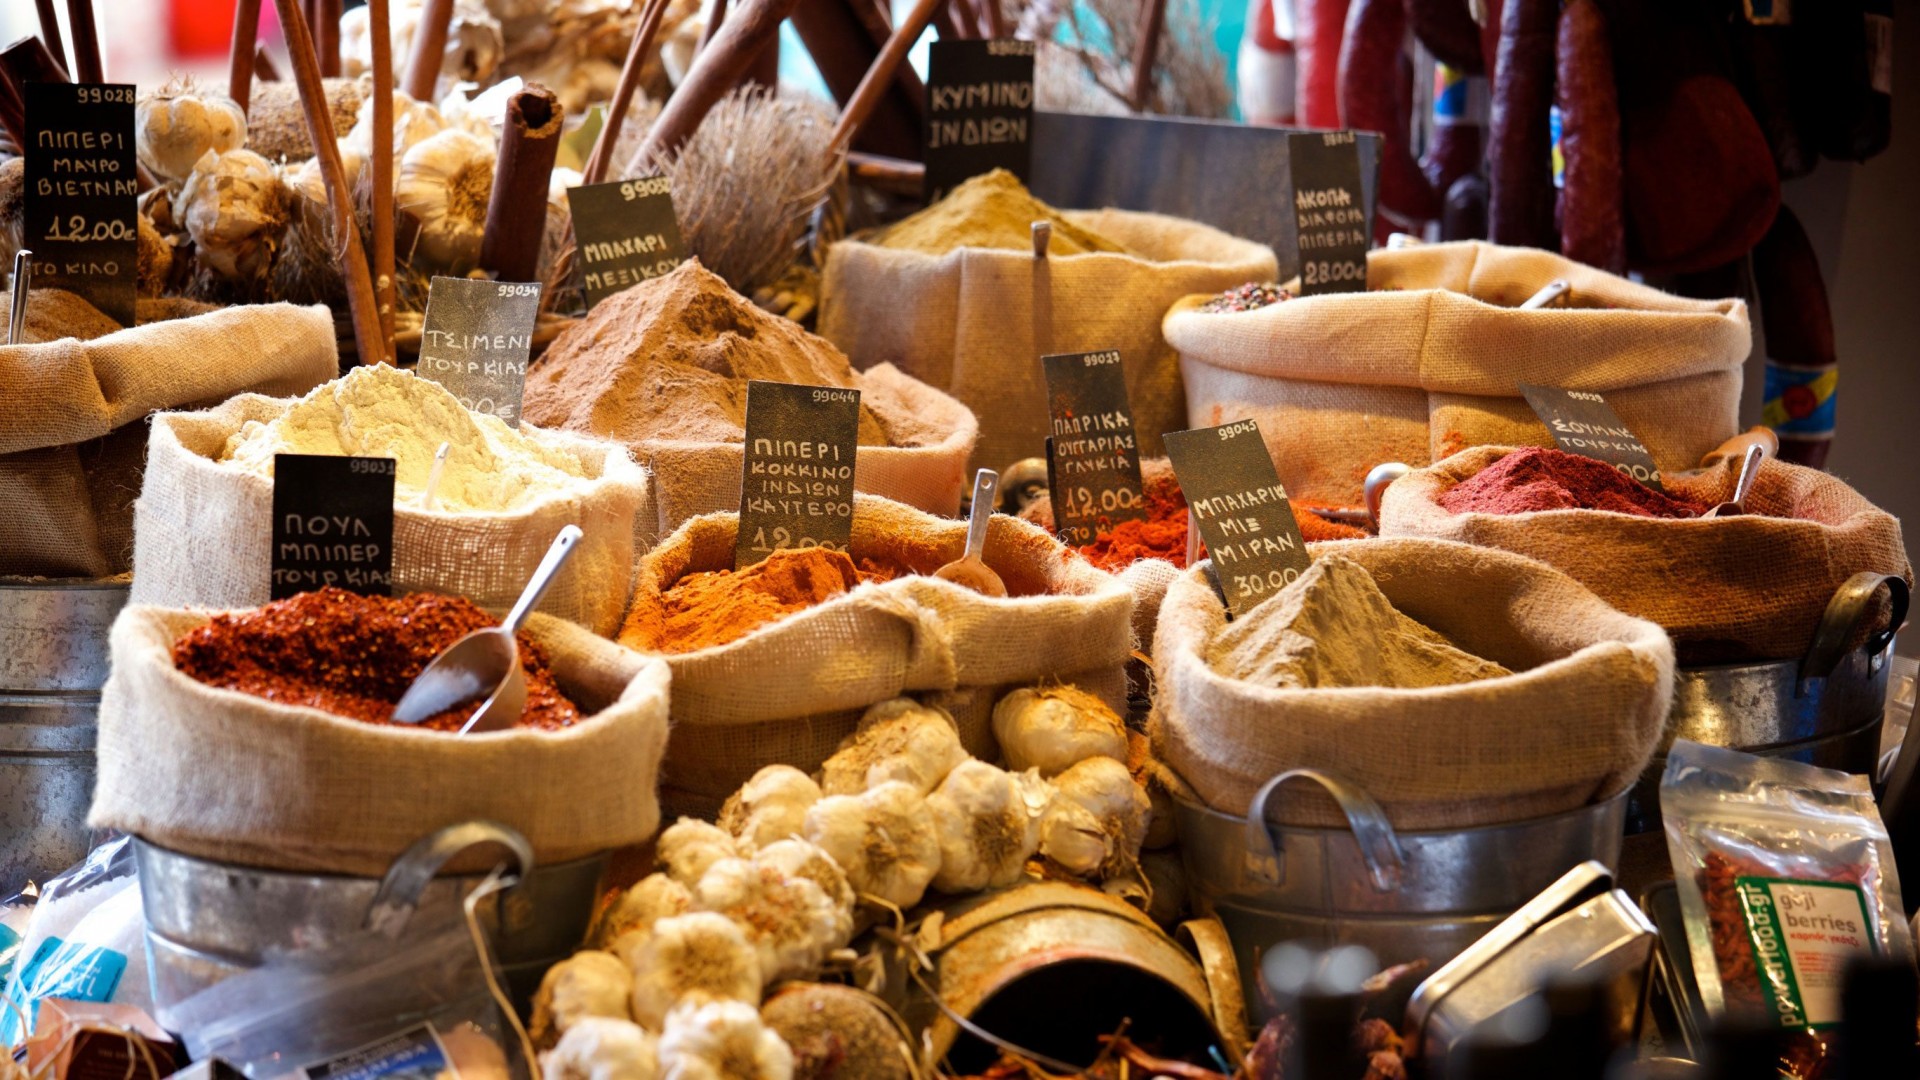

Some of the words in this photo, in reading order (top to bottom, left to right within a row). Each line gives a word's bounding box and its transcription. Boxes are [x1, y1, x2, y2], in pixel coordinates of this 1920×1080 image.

[77, 87, 135, 104] 99028
[931, 82, 1033, 112] ΚΥΜΙΝΟ
[38, 130, 123, 150] ΠΙΠΕΡΙ
[54, 158, 119, 172] ΜΑΥΡΟ
[37, 177, 138, 196] ΒΙΕΤΝΑΜ
[583, 234, 667, 263] ΜΠΑΧΑΡΙ
[66, 261, 119, 275] ΚΙΛΟ
[498, 284, 539, 298] 99034
[427, 330, 532, 350] ΤΣΙΜΕΝΙ
[425, 356, 526, 375] ΤΟΥΡΚΙΑΣ
[812, 389, 855, 403] 99044
[1054, 410, 1130, 435] ΠΑΠΡΙΚΑ
[1218, 419, 1257, 441] 99045
[754, 438, 839, 461] ΠΙΠΕΡΙ
[350, 459, 395, 475] 99031
[751, 461, 851, 479] ΚΟΚΚΙΝΟ
[1065, 455, 1130, 473] ΓΛΥΚΙΑ
[763, 480, 840, 496] ΙΝΔΙΩΝ
[748, 497, 851, 517] ΚΑΥΤΕΡΟ
[285, 513, 371, 537] ΠΟΥΛ
[1219, 517, 1261, 537] ΜΙΞ
[281, 542, 380, 562] ΜΠΙΠΕΡ
[1214, 532, 1295, 565] ΜΙΡΑΝ
[1785, 912, 1857, 933] berries
